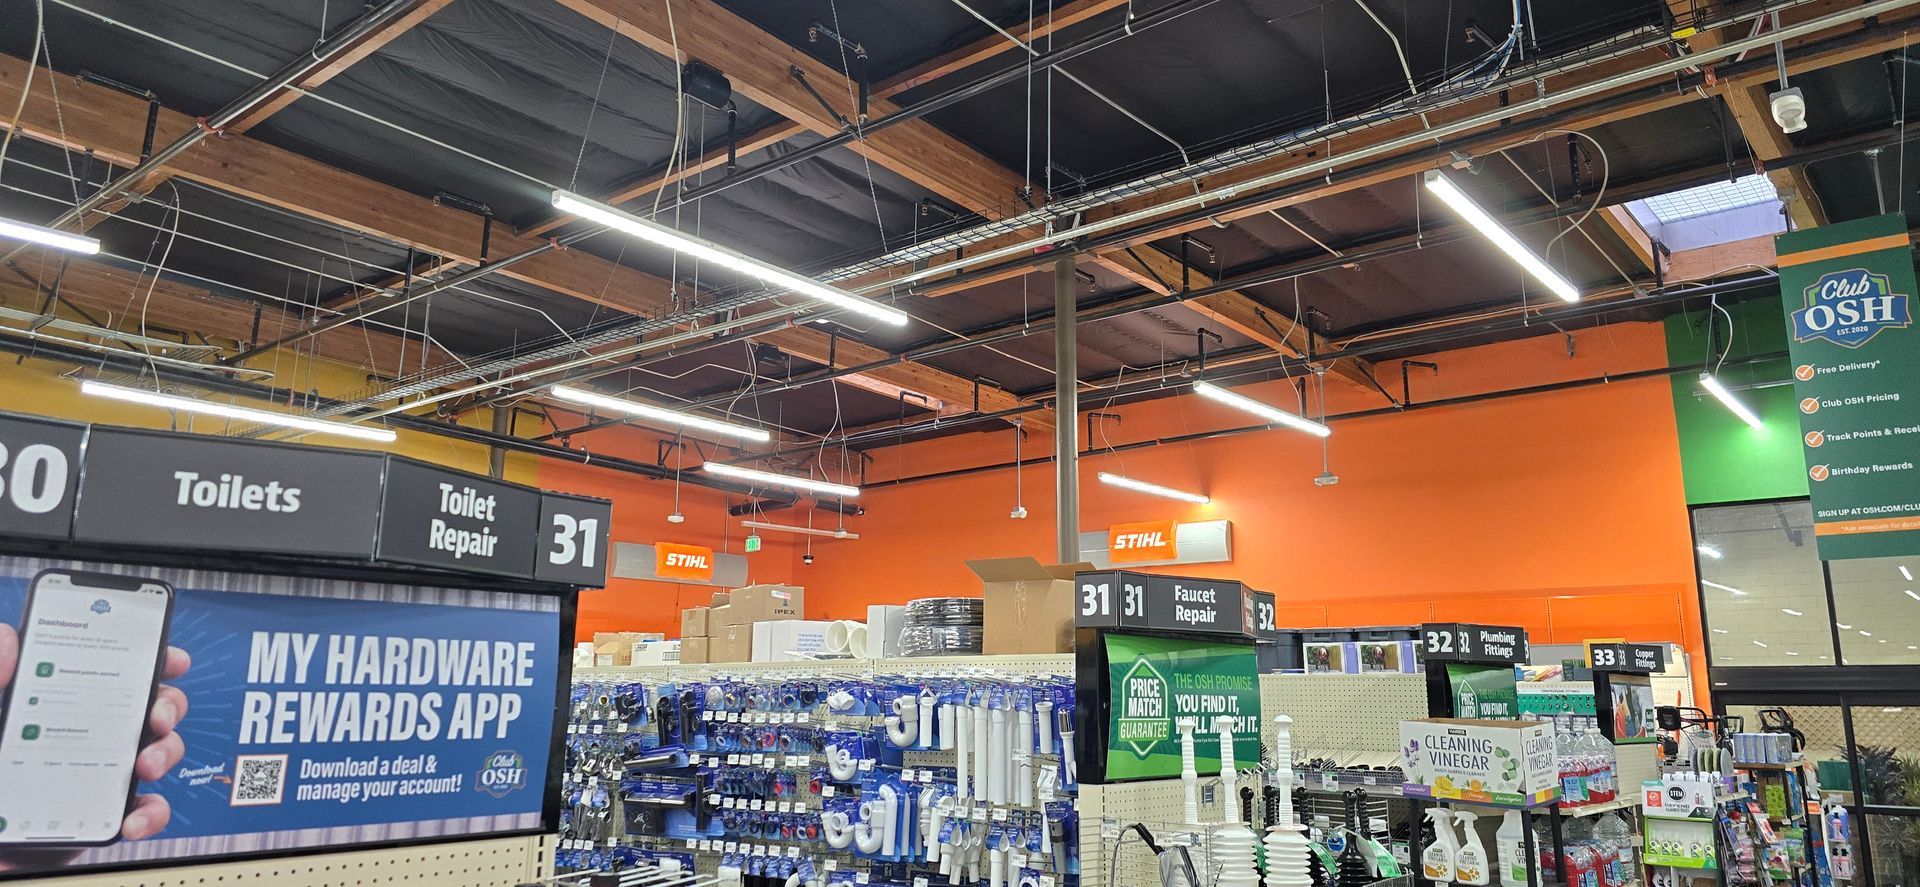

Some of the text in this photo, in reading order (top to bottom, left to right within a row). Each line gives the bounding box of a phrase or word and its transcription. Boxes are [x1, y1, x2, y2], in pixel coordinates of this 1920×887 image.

[1822, 274, 1870, 300] Club
[1804, 296, 1895, 331] OSH
[1817, 367, 1836, 375] Free
[1822, 393, 1900, 408] Club OSH Pricing
[1827, 432, 1851, 442] Track
[1853, 430, 1882, 438] Points
[1884, 428, 1892, 436] &
[0, 441, 301, 513] 0 Toilets
[1832, 462, 1913, 476] Birthday Rewards
[439, 482, 496, 522] Toilet
[429, 518, 498, 559] Repair
[550, 514, 598, 568] 31
[1114, 531, 1166, 549] STIHL
[666, 553, 709, 569] STIHL
[1082, 583, 1110, 616] 31
[1124, 583, 1144, 617] 31
[1175, 585, 1216, 604] Faucet
[38, 618, 89, 629] Dashboard
[1175, 605, 1217, 625] Repair
[1258, 602, 1275, 630] 32
[1427, 630, 1516, 653] 32 32 Plumbing
[1485, 644, 1514, 658] Fittings
[247, 631, 535, 687] MY HARDWARE
[1594, 649, 1654, 666] 33 33 Copper
[1636, 659, 1656, 669] Fittings
[1130, 678, 1160, 698] PRICE
[1174, 672, 1253, 690] THE OSH PROMISE
[1128, 697, 1162, 717] MATCH
[1175, 694, 1240, 715] YOU FIND IT,
[1480, 702, 1490, 715] YOU
[1492, 702, 1502, 715] FIND
[238, 691, 522, 744] REWARDS APP
[1210, 716, 1245, 734] MCH
[1247, 716, 1258, 733] IT.
[1120, 721, 1167, 739] GUARANTEE
[1425, 735, 1492, 754] CLEANING
[1526, 736, 1553, 755] CLEANING
[179, 762, 225, 778] Download
[300, 754, 437, 779] Download a deal &
[492, 754, 515, 768] Club
[1429, 751, 1490, 770] VINEGAR
[1528, 752, 1554, 771] VINEGAR
[482, 768, 522, 785] OSH
[297, 773, 463, 803] manage your account!
